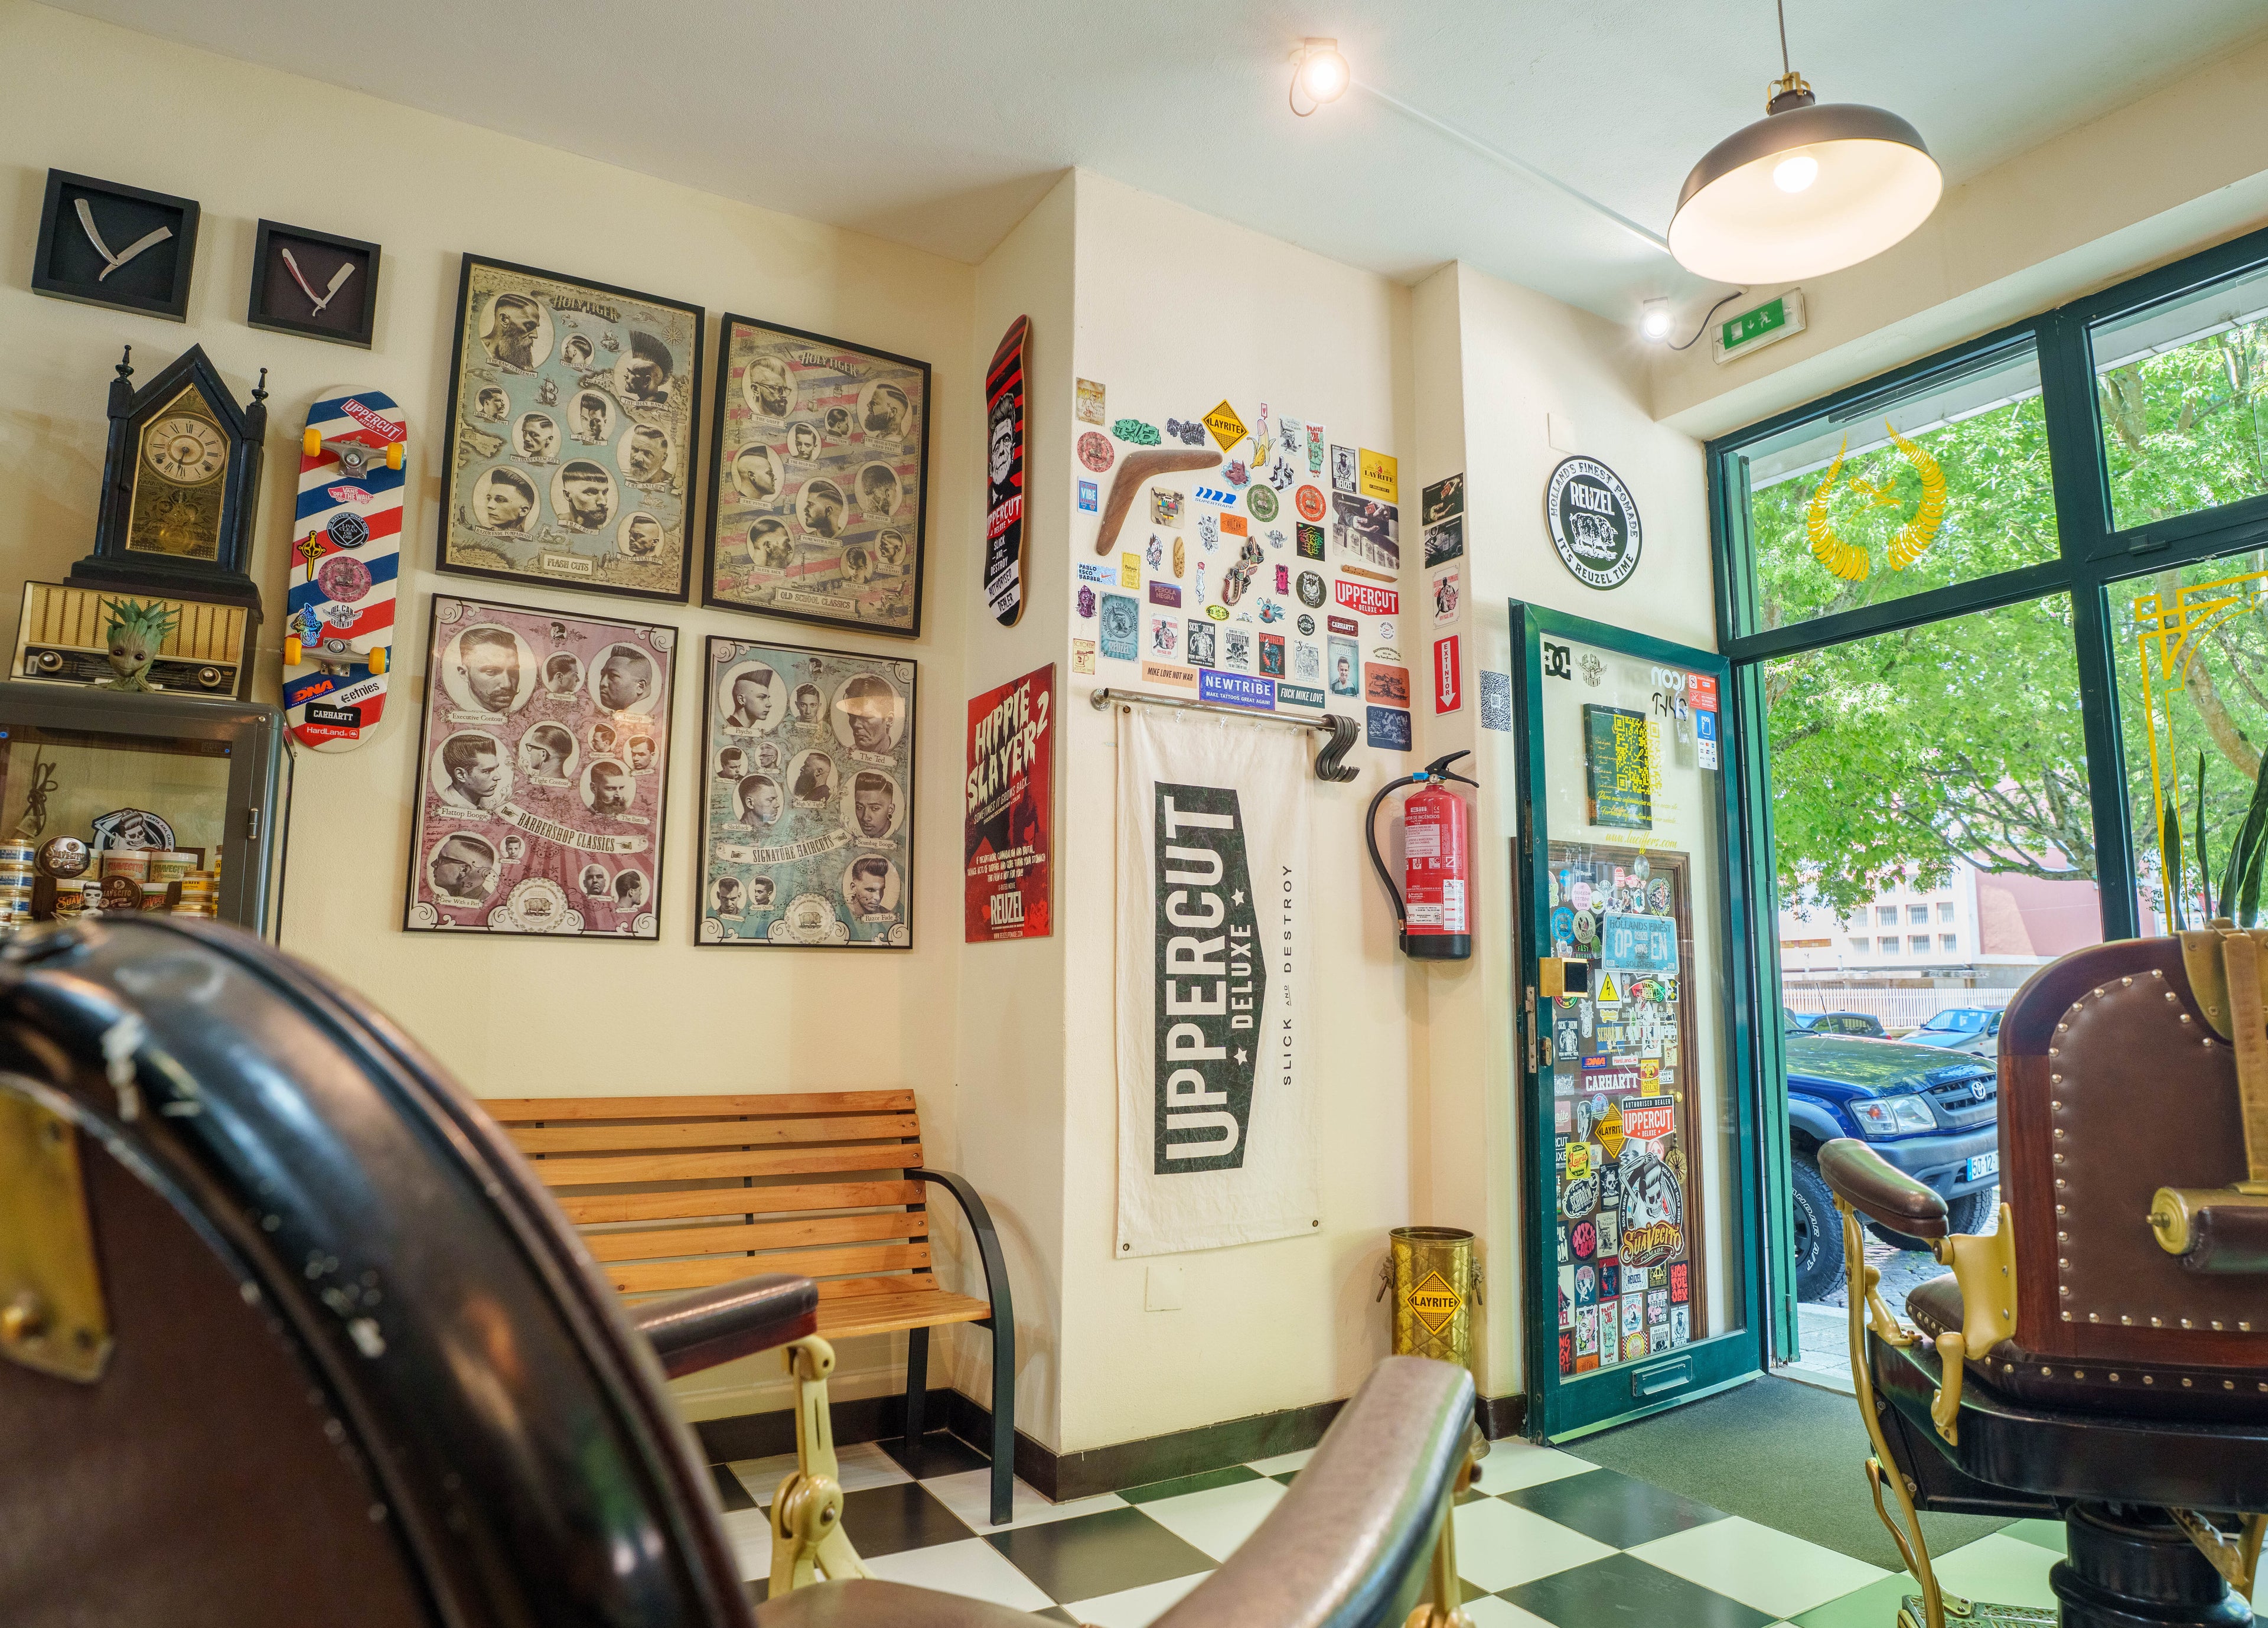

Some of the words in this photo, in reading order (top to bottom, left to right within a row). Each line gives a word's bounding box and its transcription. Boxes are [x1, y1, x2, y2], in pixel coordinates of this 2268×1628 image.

[510, 364, 535, 377] GENTLEMAN
[345, 401, 400, 438] UPPERCUT
[359, 418, 375, 429] DELUXE
[1209, 417, 1241, 434] LAYRITE
[1364, 470, 1394, 483] LAYRITE
[1336, 478, 1353, 491] REUZEL
[1081, 488, 1096, 500] VIBE
[1550, 464, 1576, 517] HOLLAND'S
[1578, 462, 1613, 484] FINEST
[1614, 484, 1638, 538] POMADE
[1570, 481, 1615, 516] REUZEL
[1194, 497, 1234, 509] SUPERTRAPP
[579, 525, 595, 534] CROP
[994, 521, 1006, 535] DELUXE
[994, 535, 1005, 551] SLICK
[547, 558, 569, 568] FLASH
[571, 562, 589, 571] CUTS
[990, 557, 1008, 576] DESTROY
[1557, 537, 1573, 563] IT'S
[1575, 562, 1612, 584] REUZEL
[1613, 553, 1634, 580] TIME
[989, 568, 1012, 597] AUTHORISED
[1079, 574, 1103, 582] BARBER.
[1155, 585, 1175, 595] PÉROLA
[1156, 592, 1175, 601] NEGRA
[780, 591, 793, 600] OLD
[795, 593, 820, 604] SCHOOL
[822, 596, 850, 609] CLASSICS
[998, 592, 1014, 613] DEALER
[1337, 582, 1397, 613] UPPERCUT
[341, 605, 353, 616] CAN
[1359, 604, 1377, 613] DELUXE
[331, 617, 353, 628] GROOMING
[1128, 608, 1138, 632] SCHOOL
[1331, 621, 1354, 631] CARHARTT
[1226, 633, 1249, 647] SCHOREM
[1259, 633, 1284, 645] SCHOREM
[1109, 642, 1130, 654] REUZEL
[1336, 646, 1353, 656] REUZEL
[1148, 668, 1159, 676] MIKE
[1160, 669, 1172, 678] LOVE
[1172, 671, 1182, 679] NOT
[1183, 673, 1193, 682] WAR
[296, 680, 334, 702] DNA
[350, 682, 380, 701] etnies
[1205, 675, 1270, 696] NEWTRIBE
[1280, 688, 1294, 699] FUCK
[1295, 690, 1309, 701] MIKE
[1309, 692, 1323, 704] LOVE
[313, 709, 353, 721] CARHARTT
[452, 712, 480, 721] Executive
[976, 679, 1030, 766] HIPPIE
[307, 727, 345, 736] HardLand
[735, 728, 752, 736] Psycho
[860, 752, 872, 761] The
[875, 754, 885, 764] Ted
[967, 720, 1037, 816] SLAYER
[1037, 691, 1050, 740] 2
[533, 776, 548, 786] Tight
[549, 778, 569, 786] Contour
[1597, 791, 1611, 800] Para
[146, 815, 159, 824] SANTA
[441, 808, 465, 818] Flattop
[467, 810, 488, 820] Boogie
[517, 812, 574, 844] BARBERSHOP
[576, 832, 615, 852] CLASSICS
[752, 846, 796, 862] SIGNATURE
[796, 835, 835, 857] HAIRCUTS
[857, 839, 878, 848] Scumbag
[107, 862, 144, 872] SUAVECITO
[153, 864, 188, 874] SUAVECITO
[439, 897, 452, 906] Crew
[990, 891, 1024, 925] REUZEL
[1283, 865, 1293, 973] DESTROY
[1609, 919, 1647, 930] HOLLANDS
[1649, 923, 1671, 932] FINEST
[1164, 796, 1239, 1160] UPPERCUT
[1230, 923, 1254, 1030] DELUXE
[1283, 1018, 1292, 1086] SLICK
[1586, 1073, 1638, 1092] CARHARTT
[1625, 1100, 1652, 1108] AUTHORISED
[1625, 1109, 1672, 1134] UPPERCUT
[1569, 1152, 1588, 1168] Layrite
[1661, 1167, 1670, 1176] SOLD
[1570, 1186, 1592, 1210] SCHOREM
[1621, 1222, 1682, 1262] SUAVECITO
[1640, 1246, 1664, 1262] POMADE
[1627, 1274, 1641, 1284] REUZEL
[1415, 1296, 1454, 1308] LAYRITE
[1624, 1298, 1641, 1307] LAYRITE
